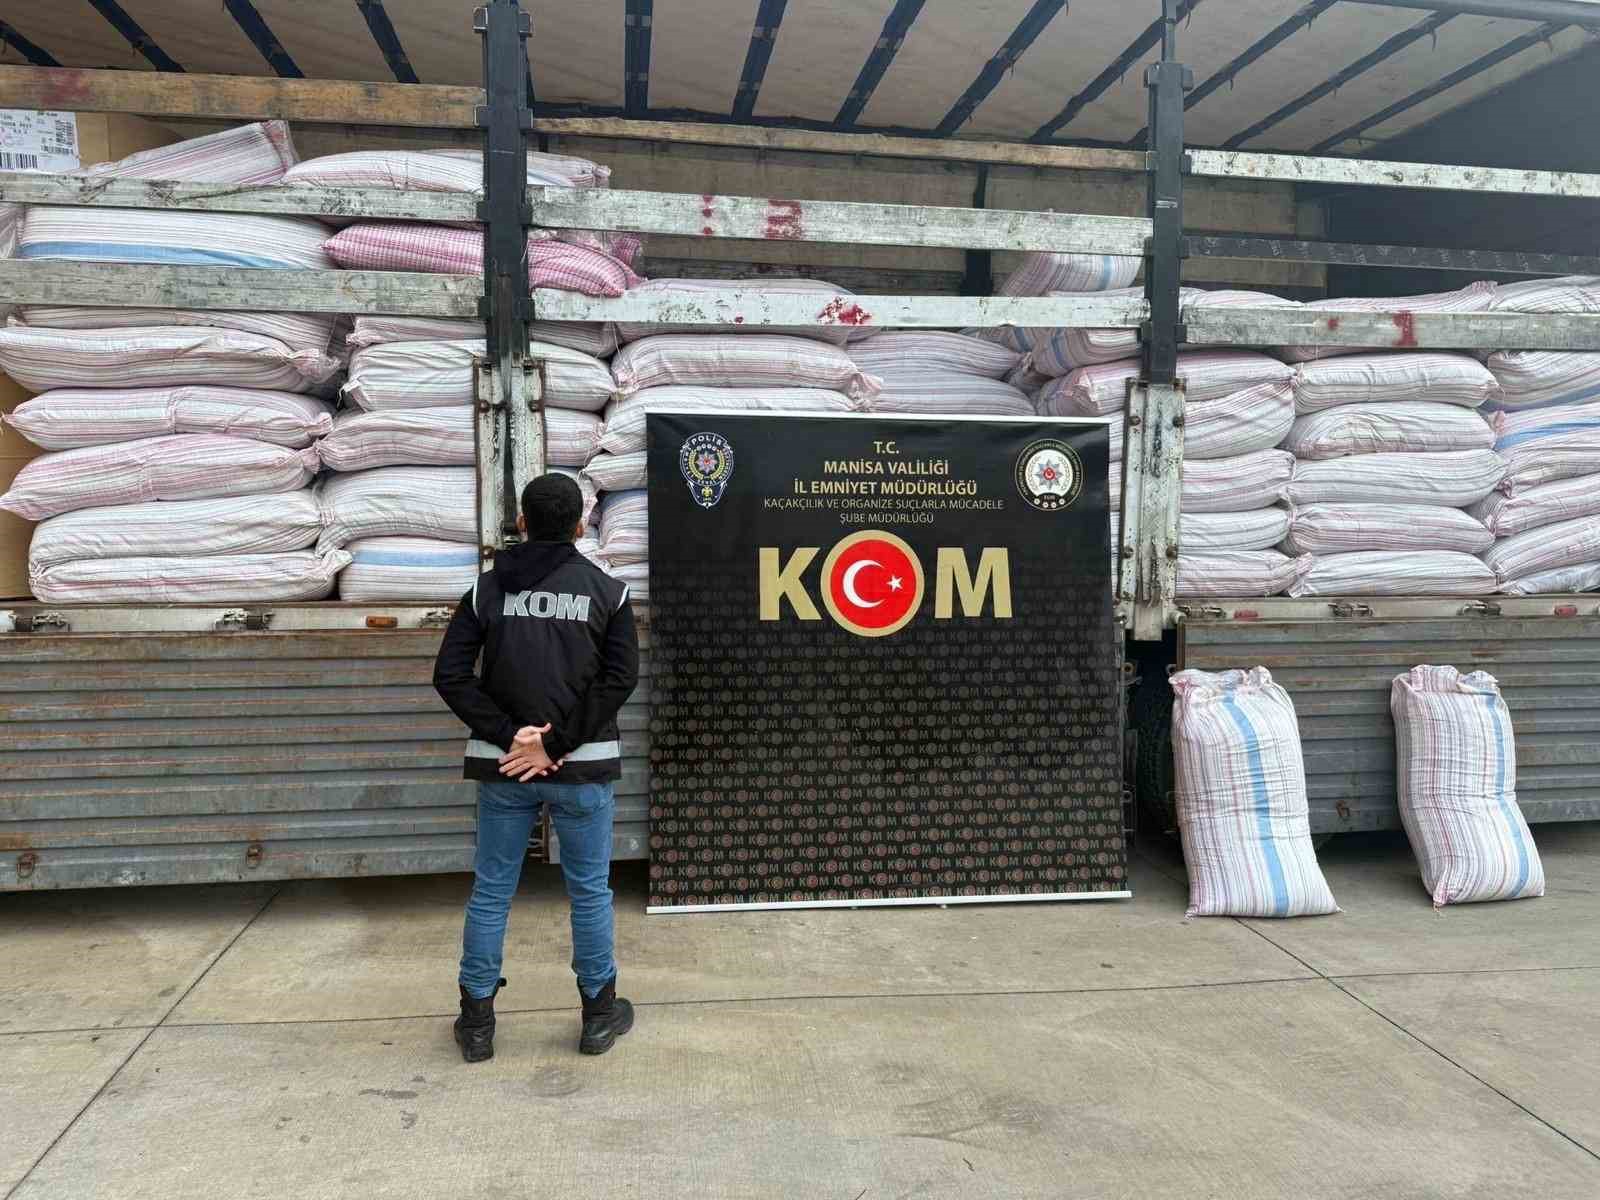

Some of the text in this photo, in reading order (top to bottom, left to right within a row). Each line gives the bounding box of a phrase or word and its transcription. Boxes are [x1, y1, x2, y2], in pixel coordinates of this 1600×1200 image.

[873, 440, 900, 454] T.C.
[823, 458, 949, 475] MANİSA VALİLİĞİ
[794, 477, 977, 496] İL EMNİYET MÜDÜRLÜĞÜ
[764, 498, 825, 511] KAÇAKÇILIK
[826, 499, 839, 509] VE
[895, 499, 947, 511] SUÇLARLA
[948, 499, 1004, 510] MÜCADELE
[839, 511, 934, 525] ŞUBE MÜDÜRLÜĞÜ
[503, 590, 592, 622] KOM
